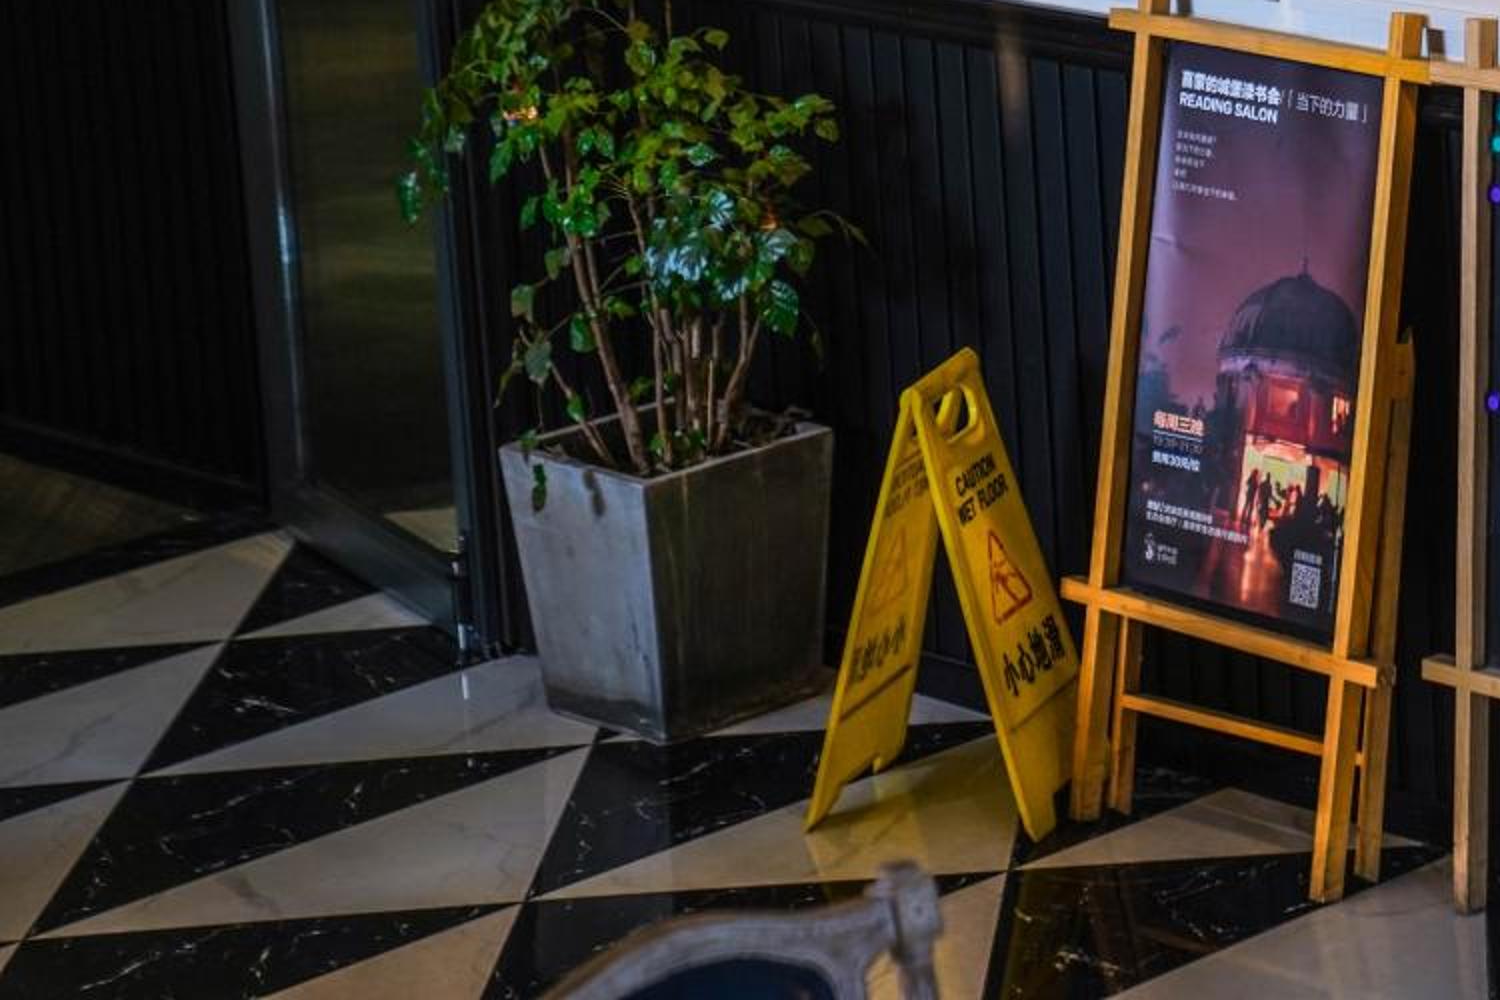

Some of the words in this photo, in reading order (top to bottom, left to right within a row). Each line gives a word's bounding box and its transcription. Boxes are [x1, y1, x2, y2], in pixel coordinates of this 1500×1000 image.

[1179, 91, 1233, 116] READING
[1234, 101, 1279, 124] SALON
[954, 451, 997, 498] CAUTION
[976, 472, 1009, 512] FLOOR
